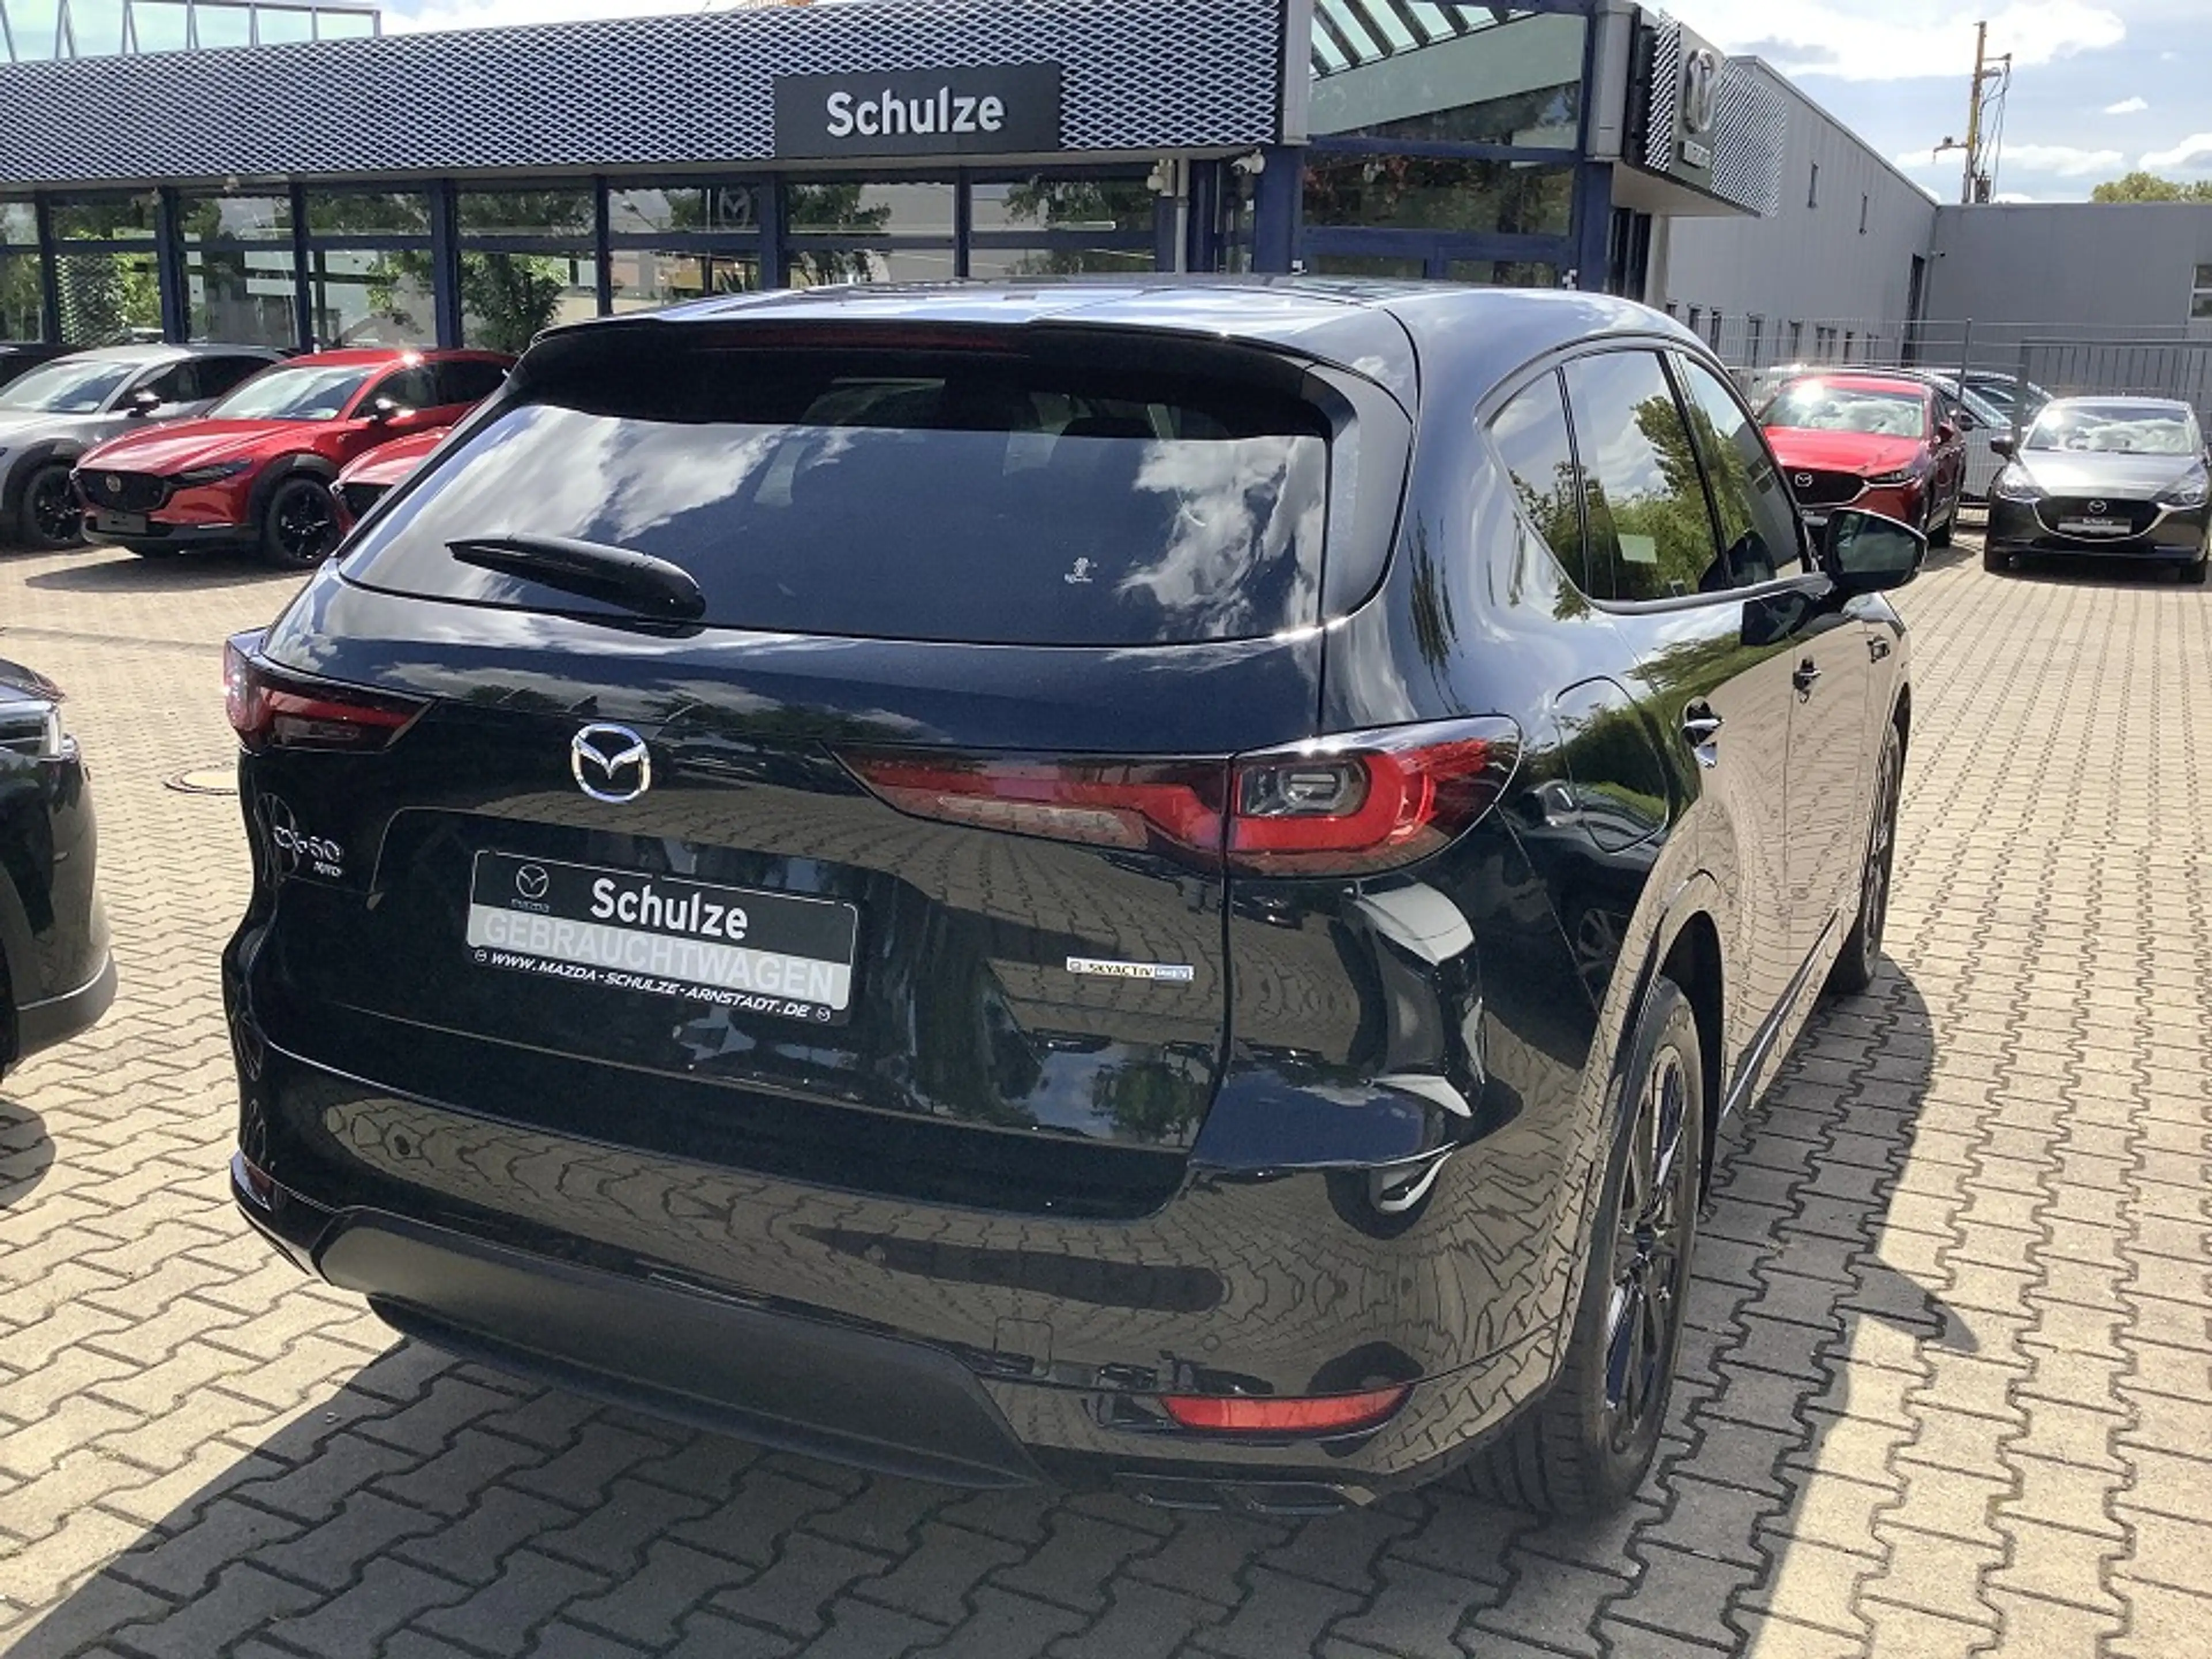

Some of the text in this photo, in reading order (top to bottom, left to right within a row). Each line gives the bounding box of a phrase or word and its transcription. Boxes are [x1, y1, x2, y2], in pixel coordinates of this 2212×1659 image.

[826, 86, 1005, 137] Schulze
[589, 877, 748, 940] Schulze
[484, 911, 834, 1005] GEBRAUCHTWAGEN
[491, 952, 811, 1018] WWW.MAZDA-SCHULZE-ARNSTADT.DE
